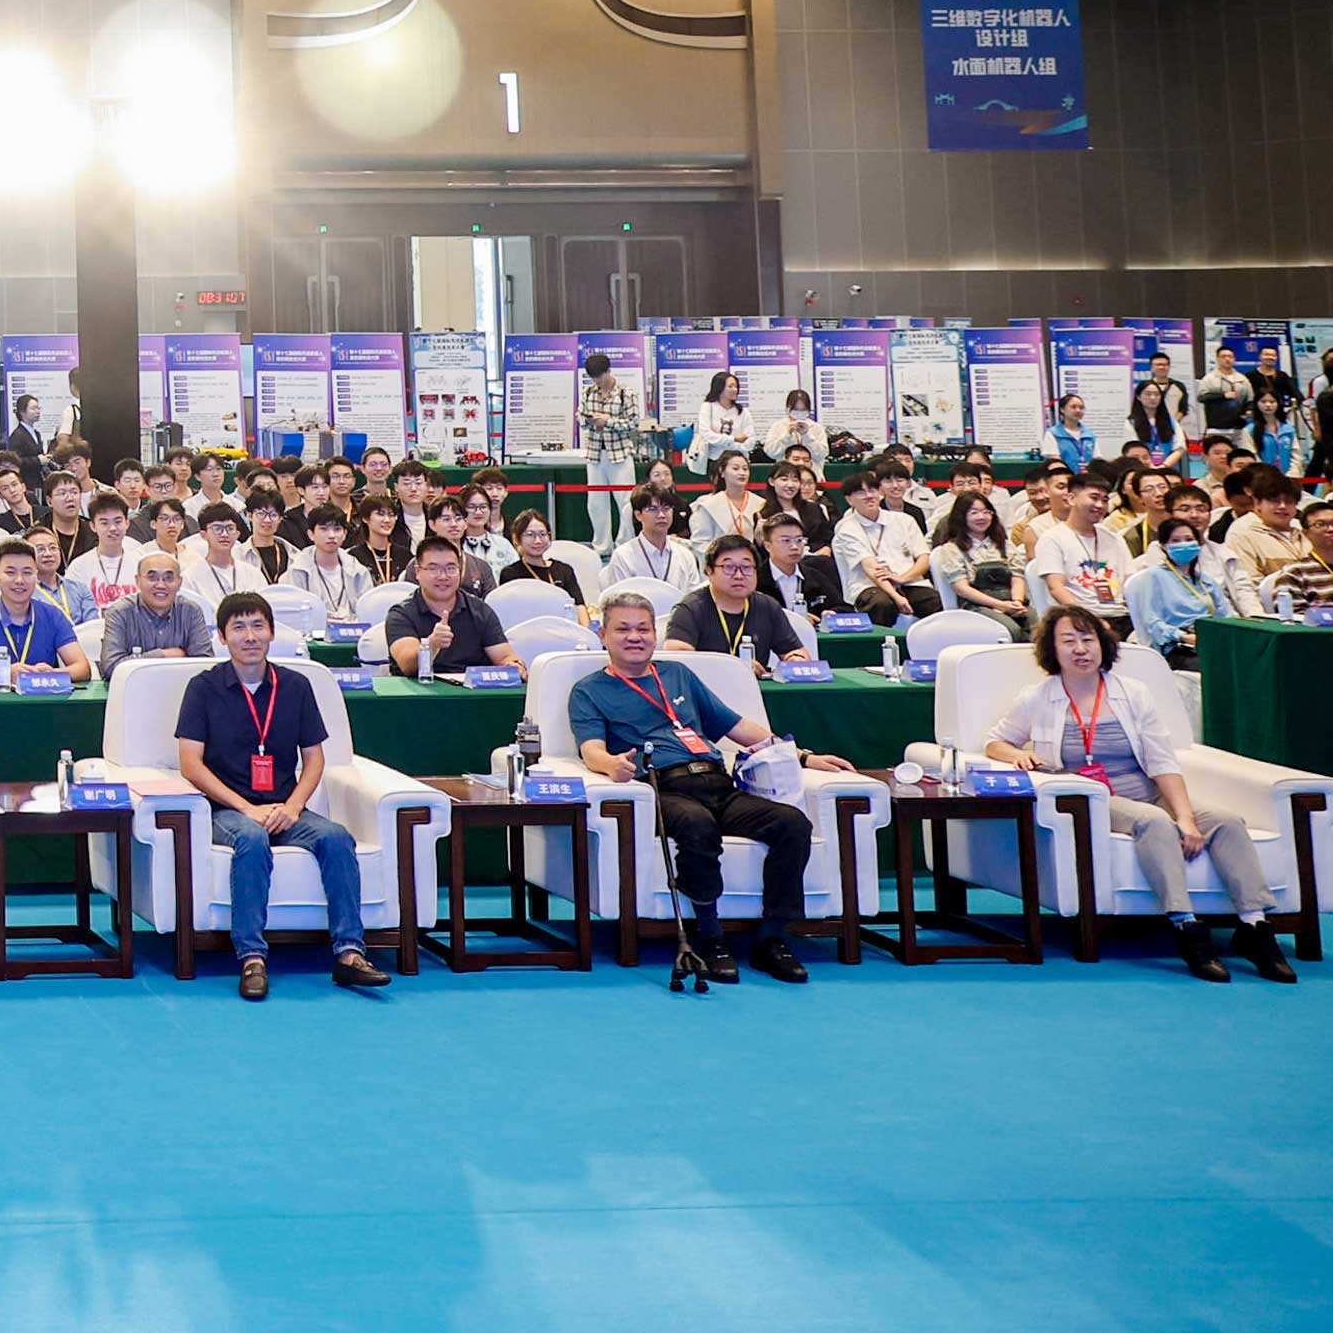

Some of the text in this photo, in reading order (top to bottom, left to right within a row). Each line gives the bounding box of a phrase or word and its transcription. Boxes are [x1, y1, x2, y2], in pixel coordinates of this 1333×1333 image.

[931, 9, 1071, 28] 三维数字化机器人
[976, 29, 1029, 48] 设计组
[952, 57, 1058, 76] 水面机器人组
[499, 72, 520, 133] 1
